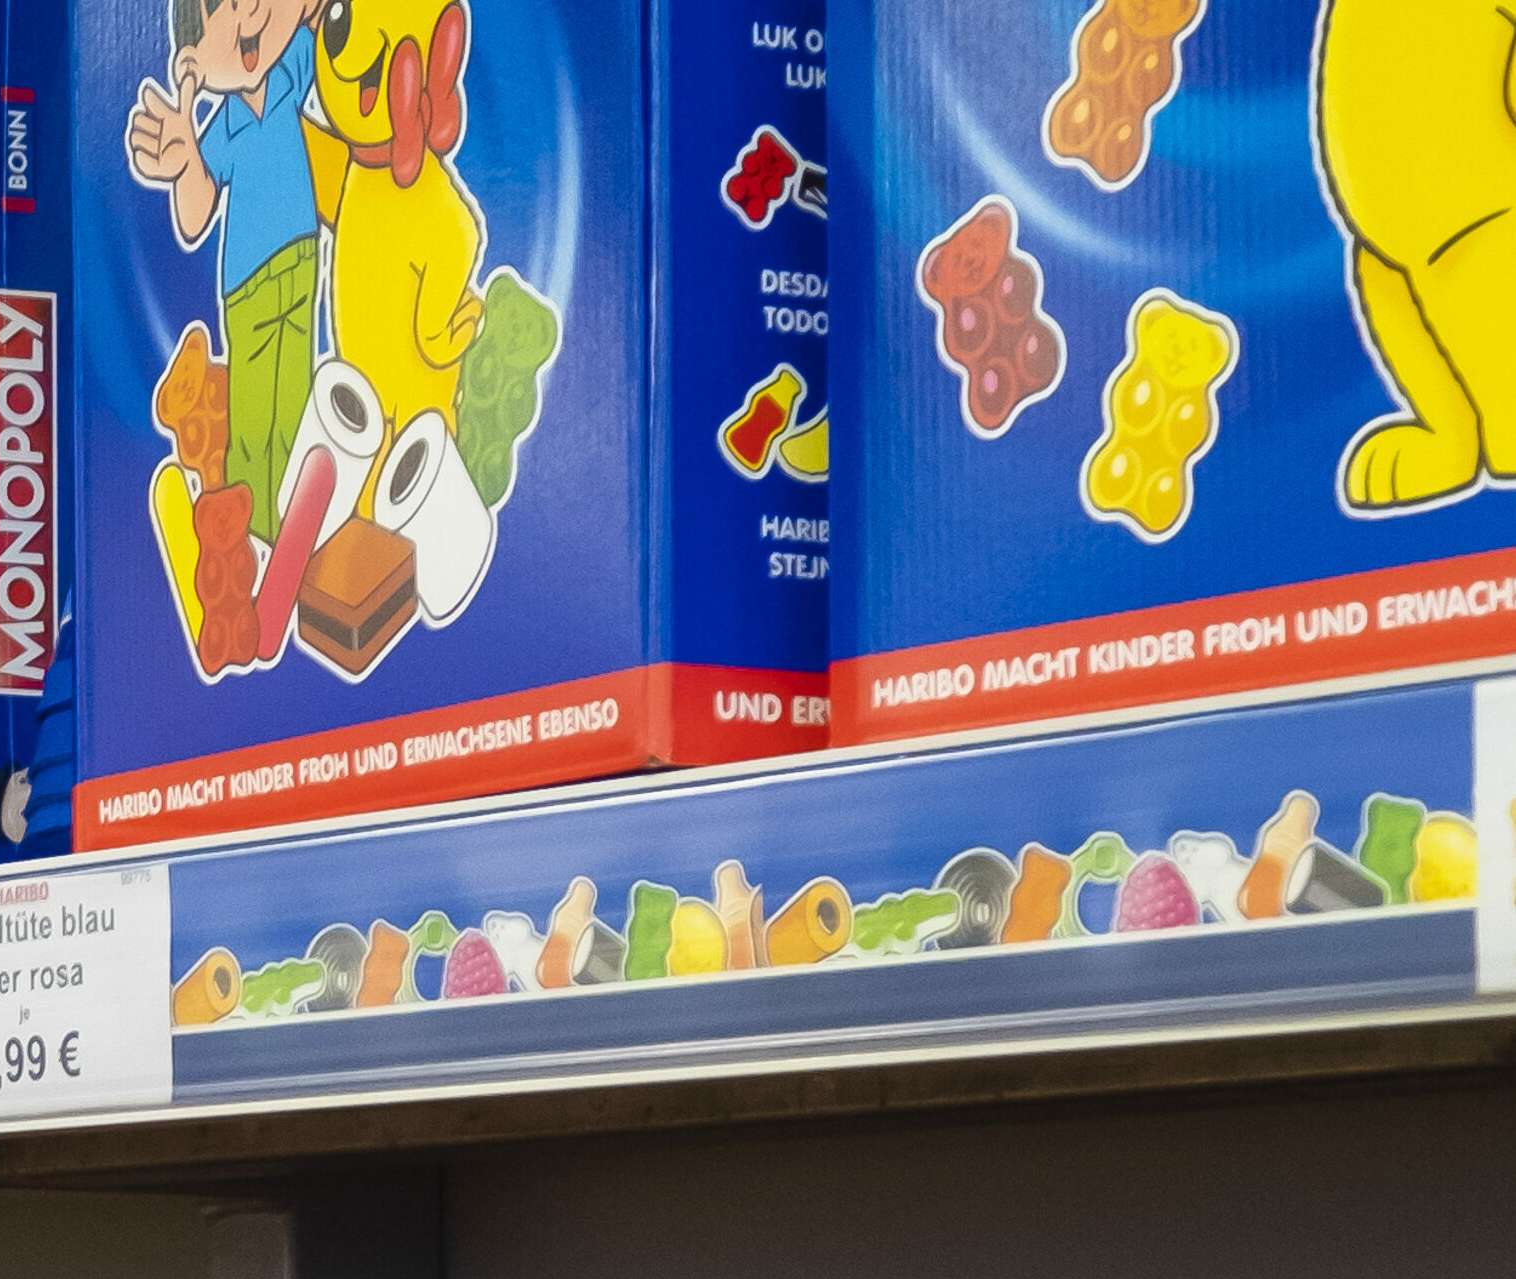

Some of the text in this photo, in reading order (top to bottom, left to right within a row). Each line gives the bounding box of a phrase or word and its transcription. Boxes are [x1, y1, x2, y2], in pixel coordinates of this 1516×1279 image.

[752, 21, 797, 50] LUK
[8, 109, 29, 191] BONN
[872, 578, 1516, 708] HARIBO MACHT KINDER FROH UND ERWACH
[715, 690, 783, 723] UND
[99, 697, 619, 824] HARIBO MACHT KINDER FROH UND ERWACHSENE EBENSO
[62, 903, 115, 937] blau
[30, 962, 84, 990] rosa
[19, 1005, 30, 1025] je
[59, 1030, 81, 1078] €
